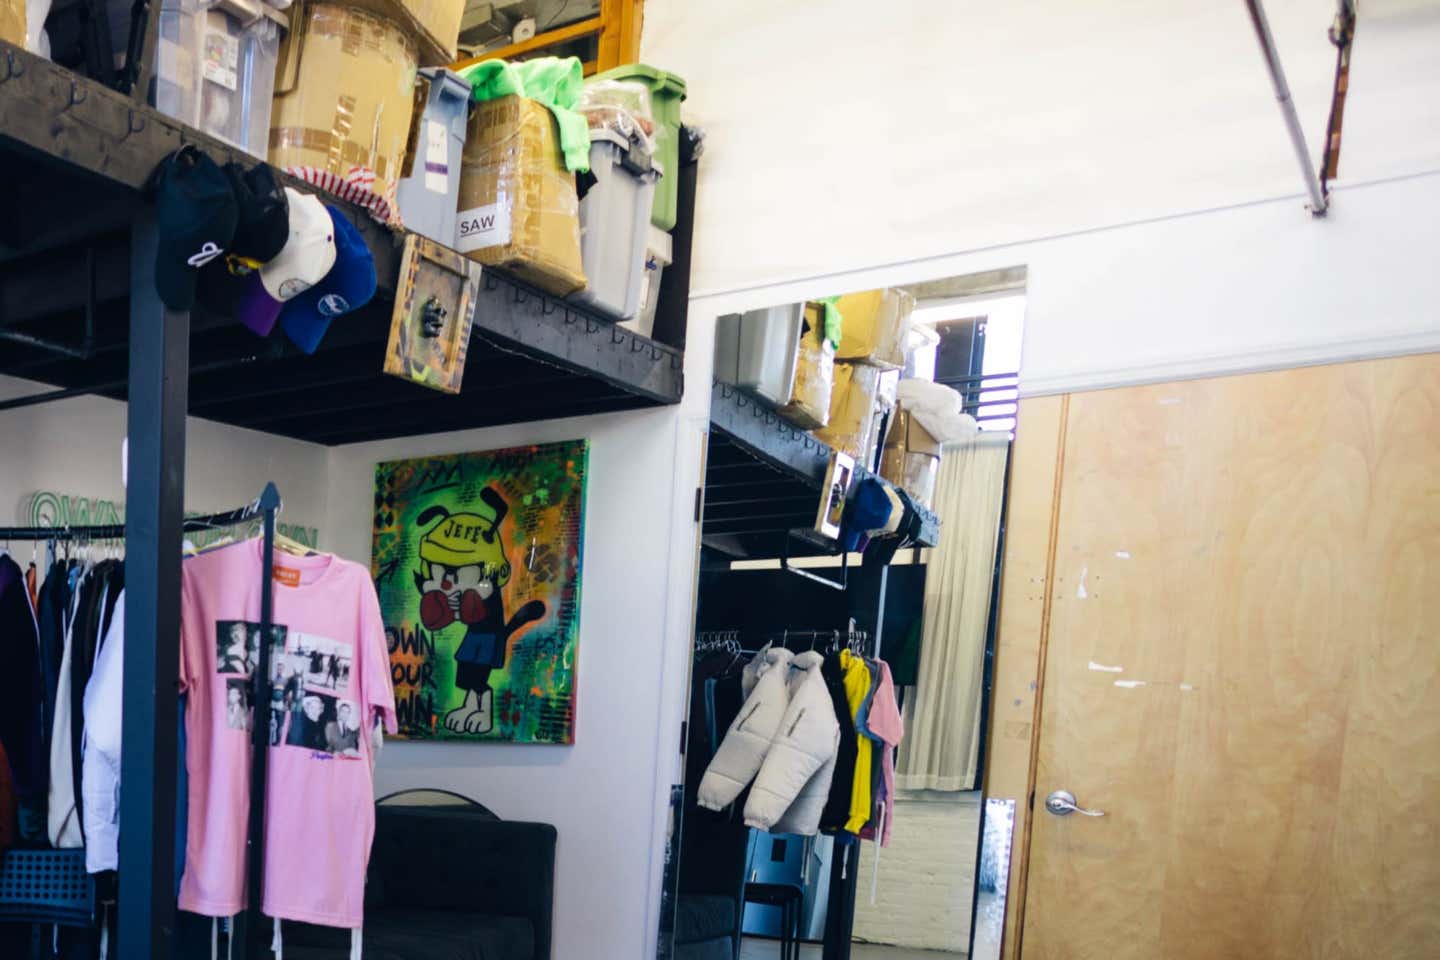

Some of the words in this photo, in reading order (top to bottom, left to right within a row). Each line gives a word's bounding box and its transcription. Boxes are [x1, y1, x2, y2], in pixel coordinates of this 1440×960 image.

[460, 214, 495, 234] SAW
[385, 623, 436, 660] OWN
[391, 663, 437, 690] OUR
[395, 690, 433, 733] WN
